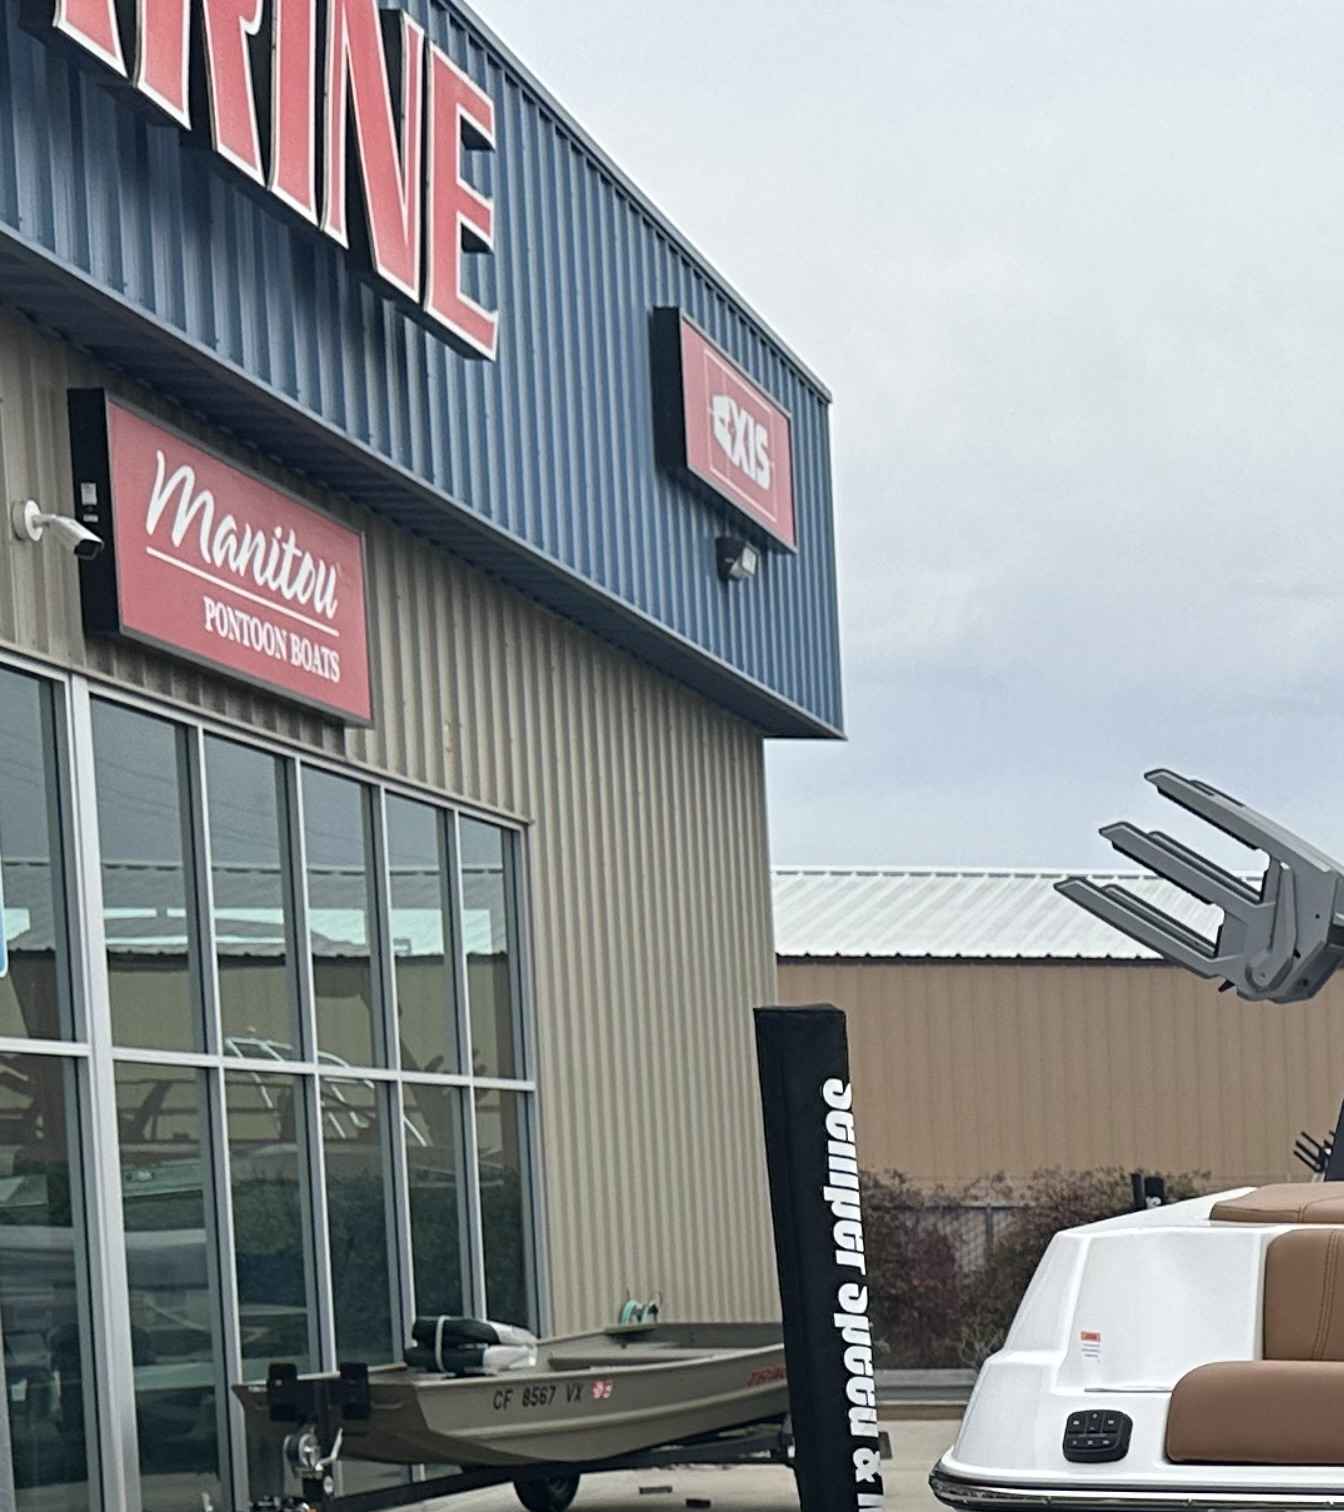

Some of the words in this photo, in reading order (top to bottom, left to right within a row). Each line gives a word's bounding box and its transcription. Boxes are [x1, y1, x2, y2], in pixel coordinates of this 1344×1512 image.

[145, 449, 338, 619] Manitou
[203, 595, 288, 666] PONTOON
[290, 631, 341, 684] BOATS
[492, 1390, 513, 1411] CF
[521, 1385, 556, 1408] 8567
[565, 1383, 584, 1403] VX
